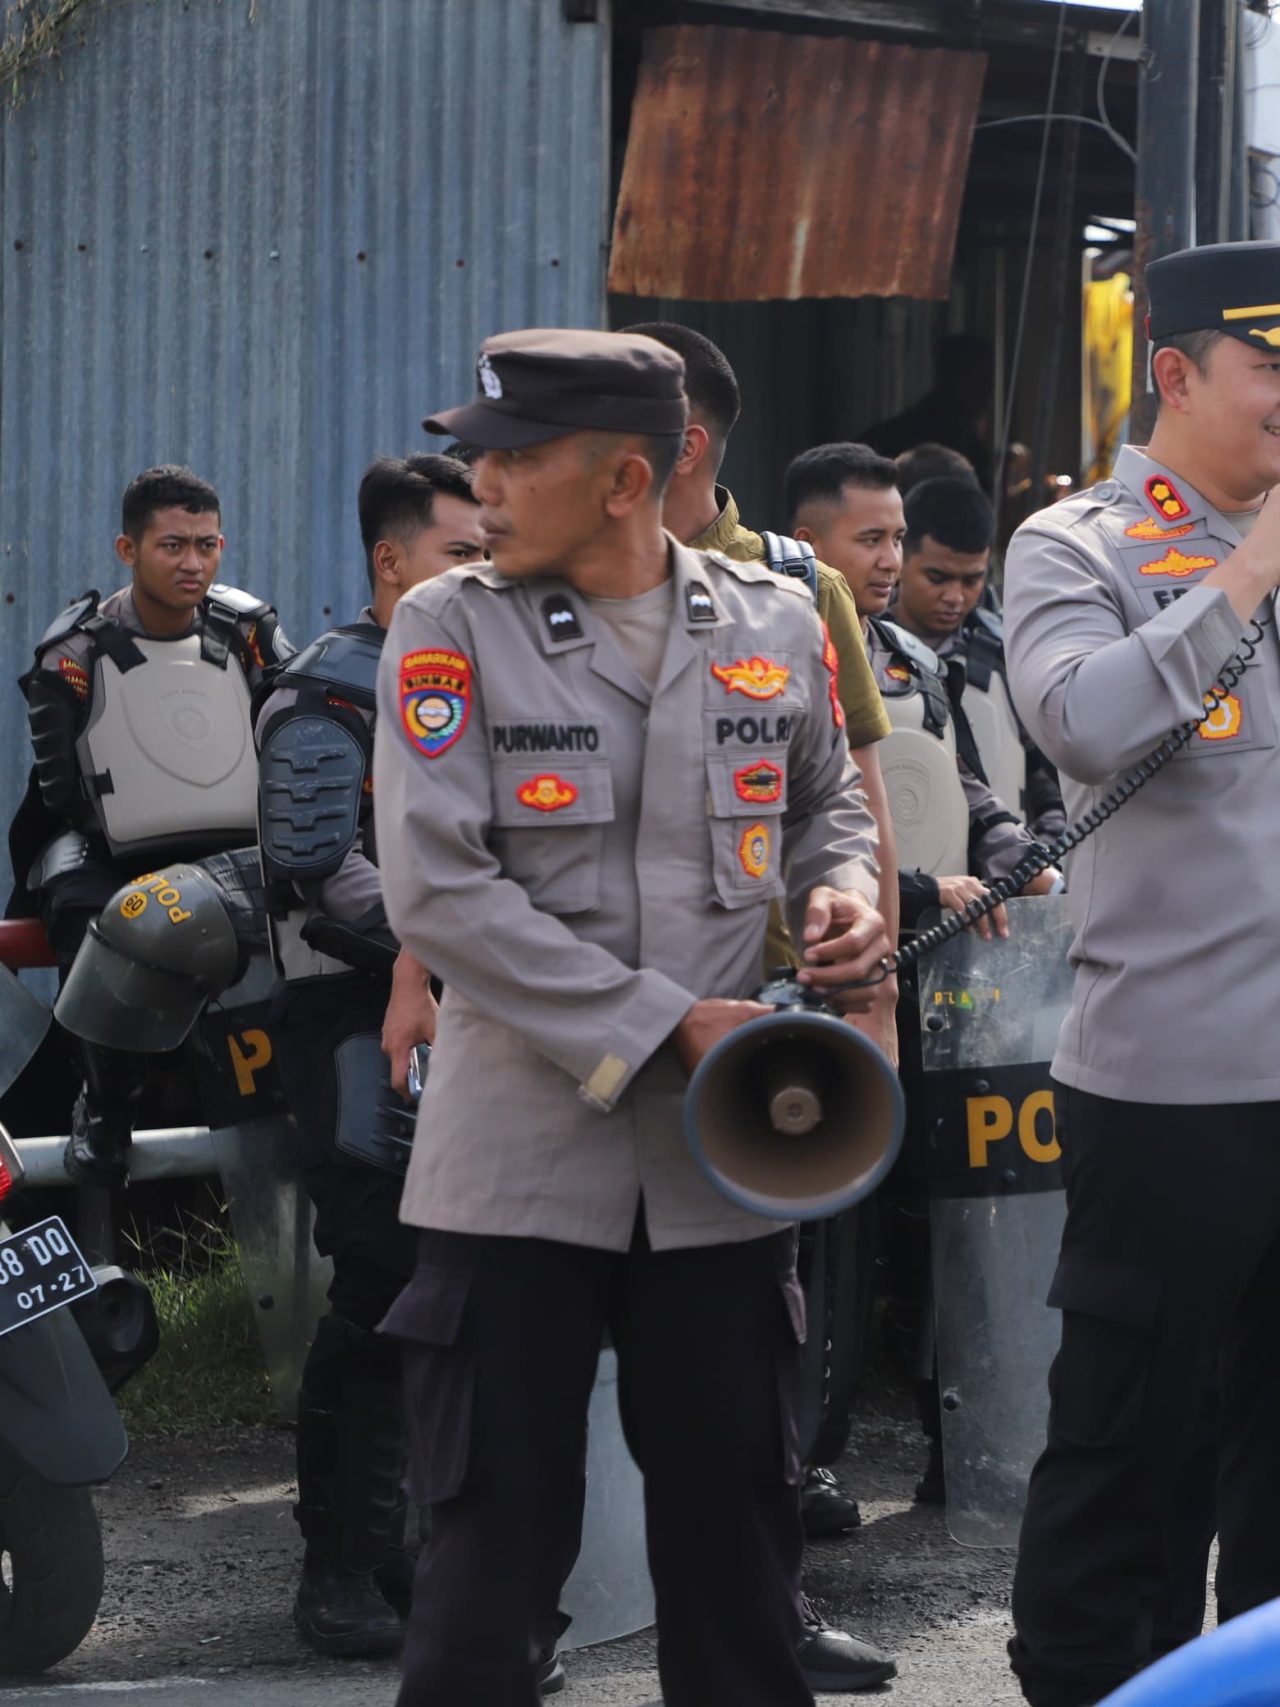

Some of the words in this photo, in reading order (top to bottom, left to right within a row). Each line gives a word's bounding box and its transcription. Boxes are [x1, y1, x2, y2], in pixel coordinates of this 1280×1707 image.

[406, 674, 465, 691] BINMAS
[493, 724, 599, 753] PURWANTO
[125, 894, 144, 912] 60
